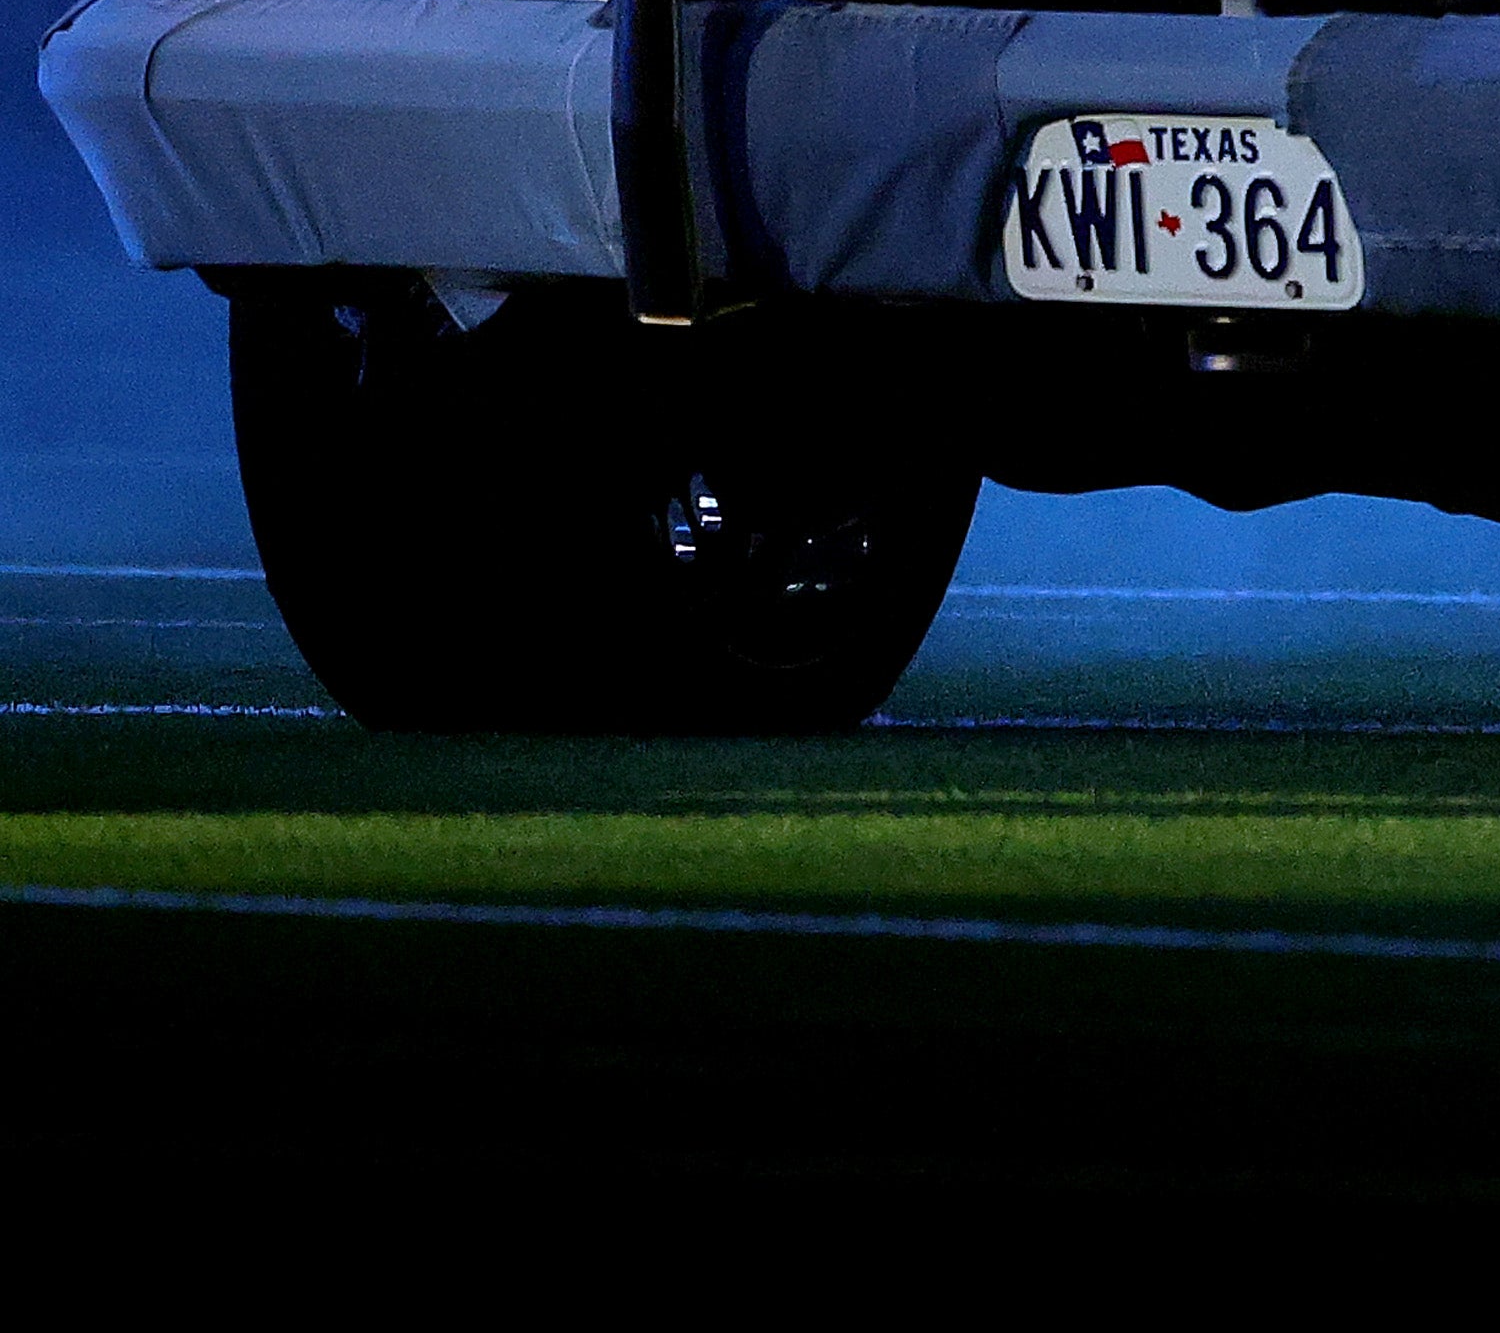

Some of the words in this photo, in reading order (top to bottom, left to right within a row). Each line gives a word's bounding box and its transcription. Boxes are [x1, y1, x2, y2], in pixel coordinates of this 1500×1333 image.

[1149, 126, 1260, 164] TEXAS
[1016, 166, 1149, 274] KWI
[1191, 174, 1342, 283] 364
